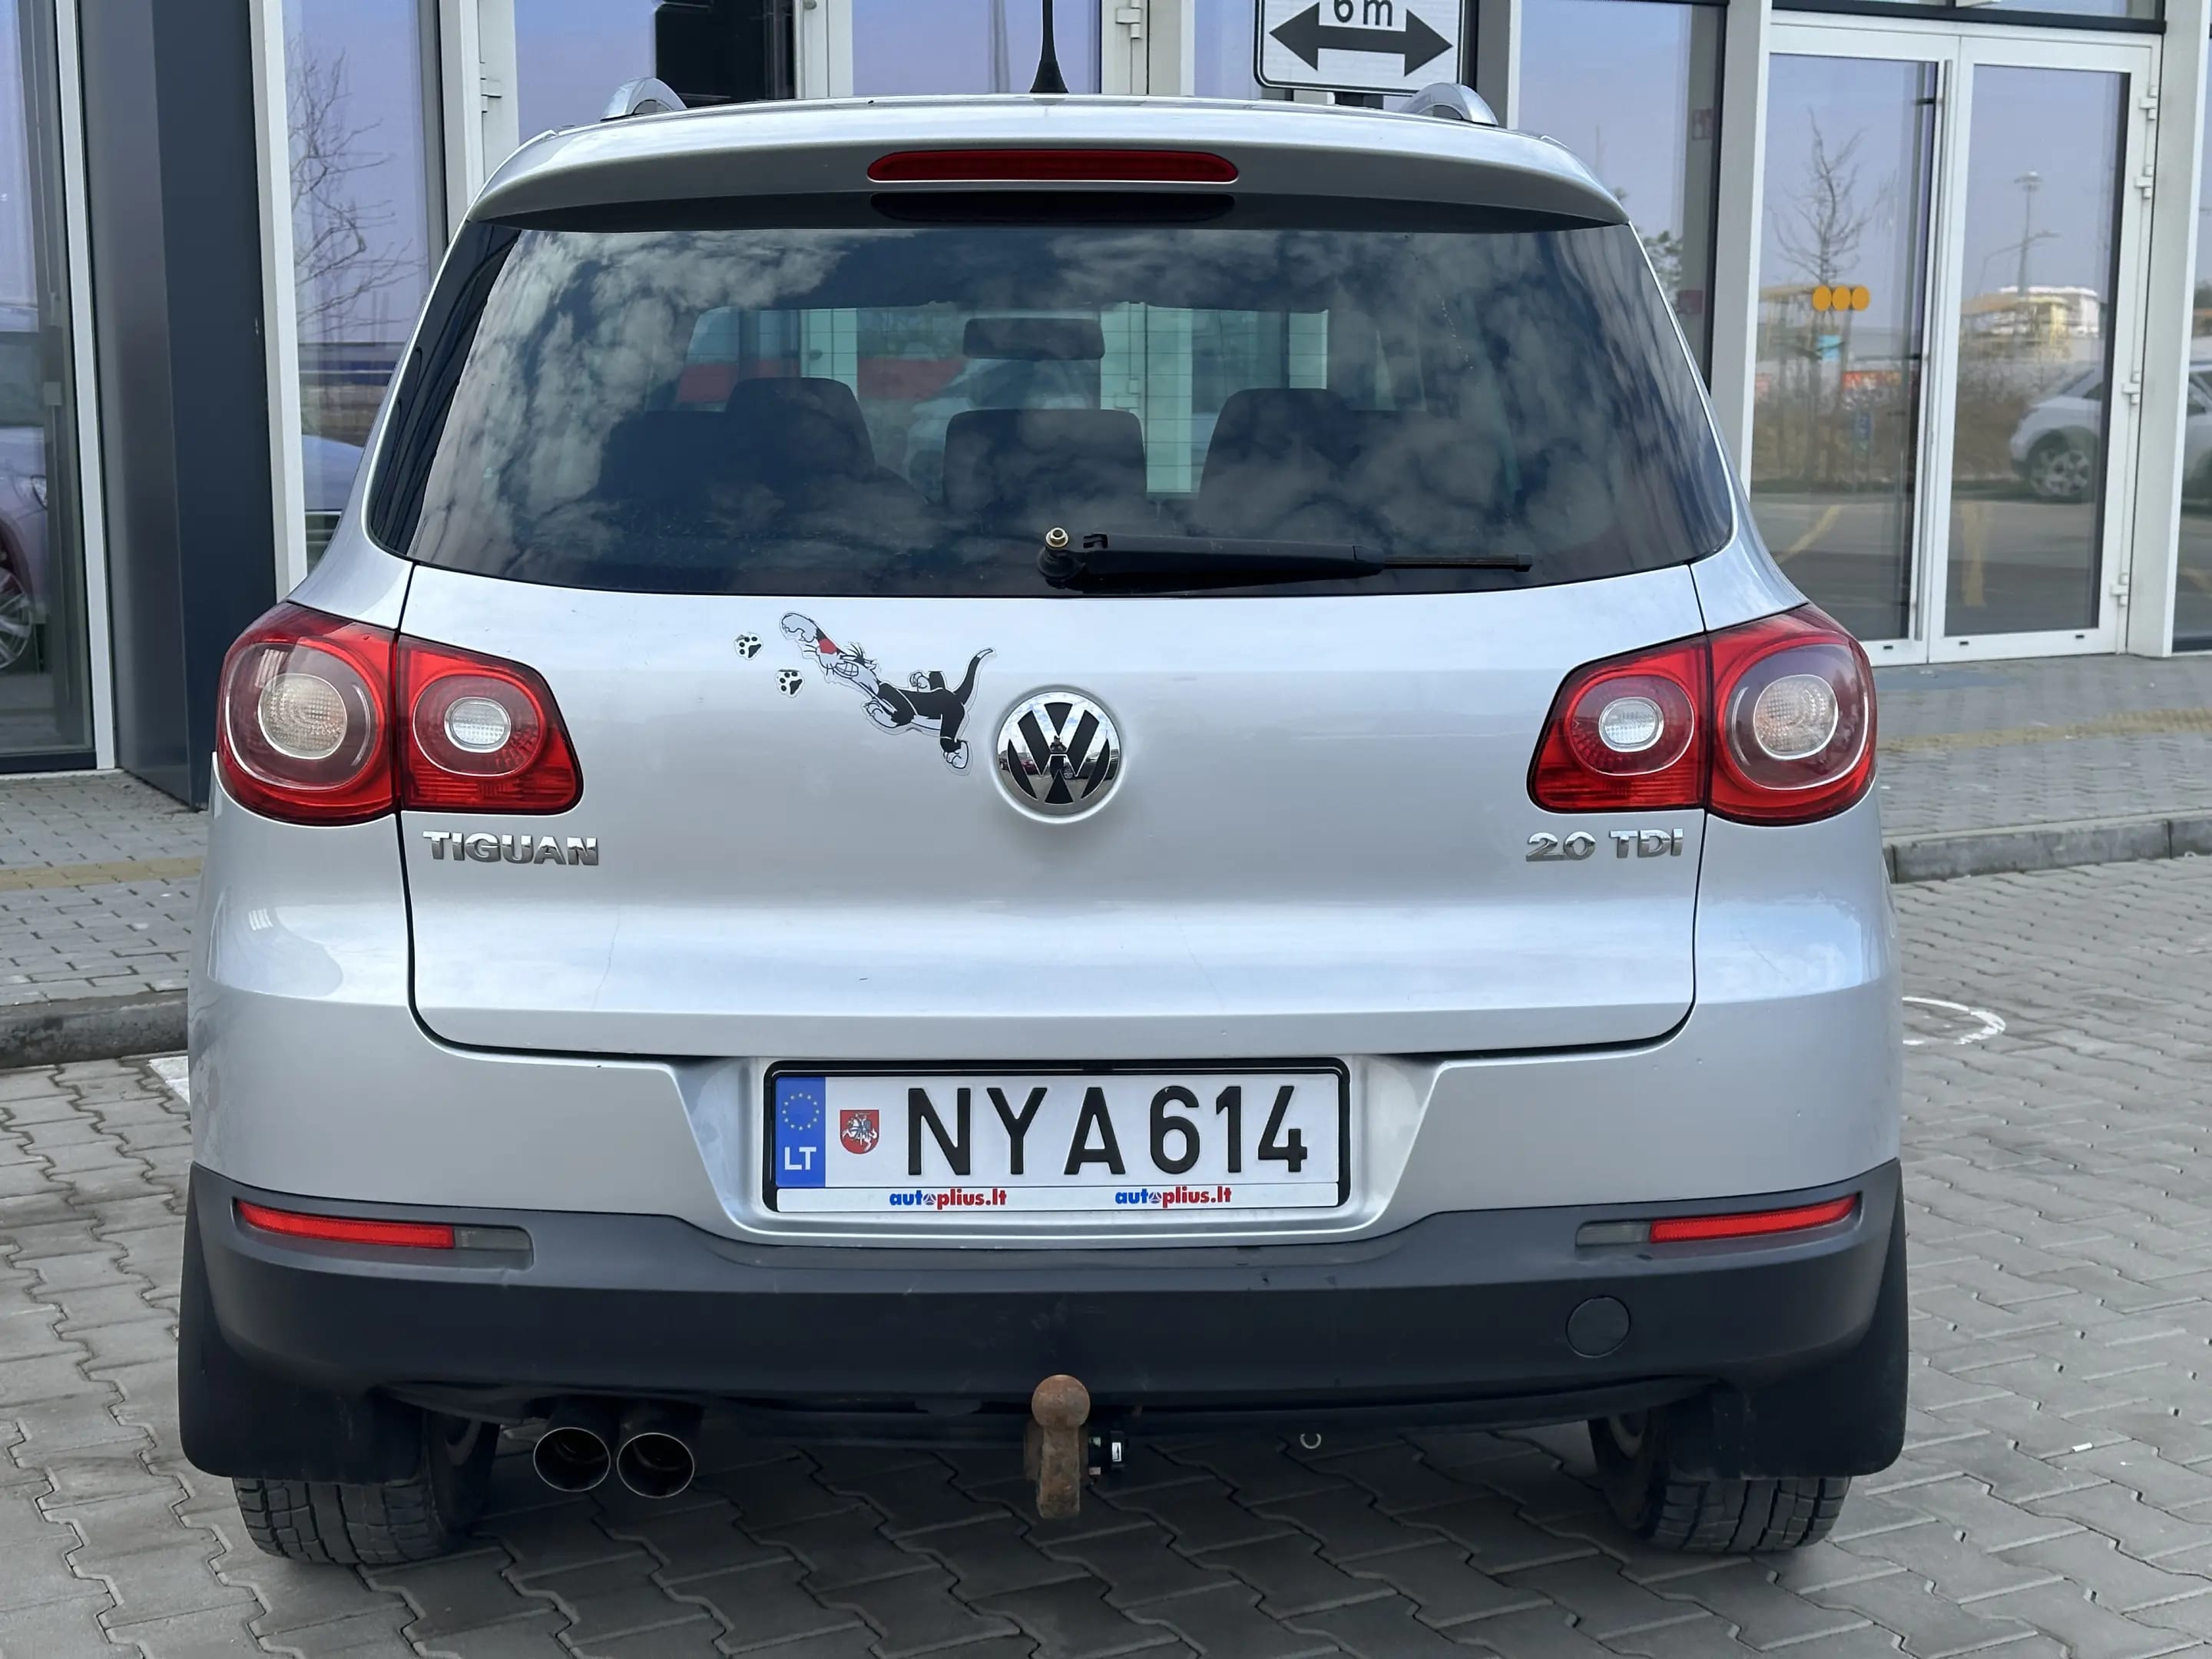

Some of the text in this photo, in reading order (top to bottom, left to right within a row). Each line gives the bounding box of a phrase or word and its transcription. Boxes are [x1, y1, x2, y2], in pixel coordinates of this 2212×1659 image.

[422, 830, 599, 866] TIGUAN
[1609, 828, 1684, 859] TDI
[784, 1147, 817, 1171] LT
